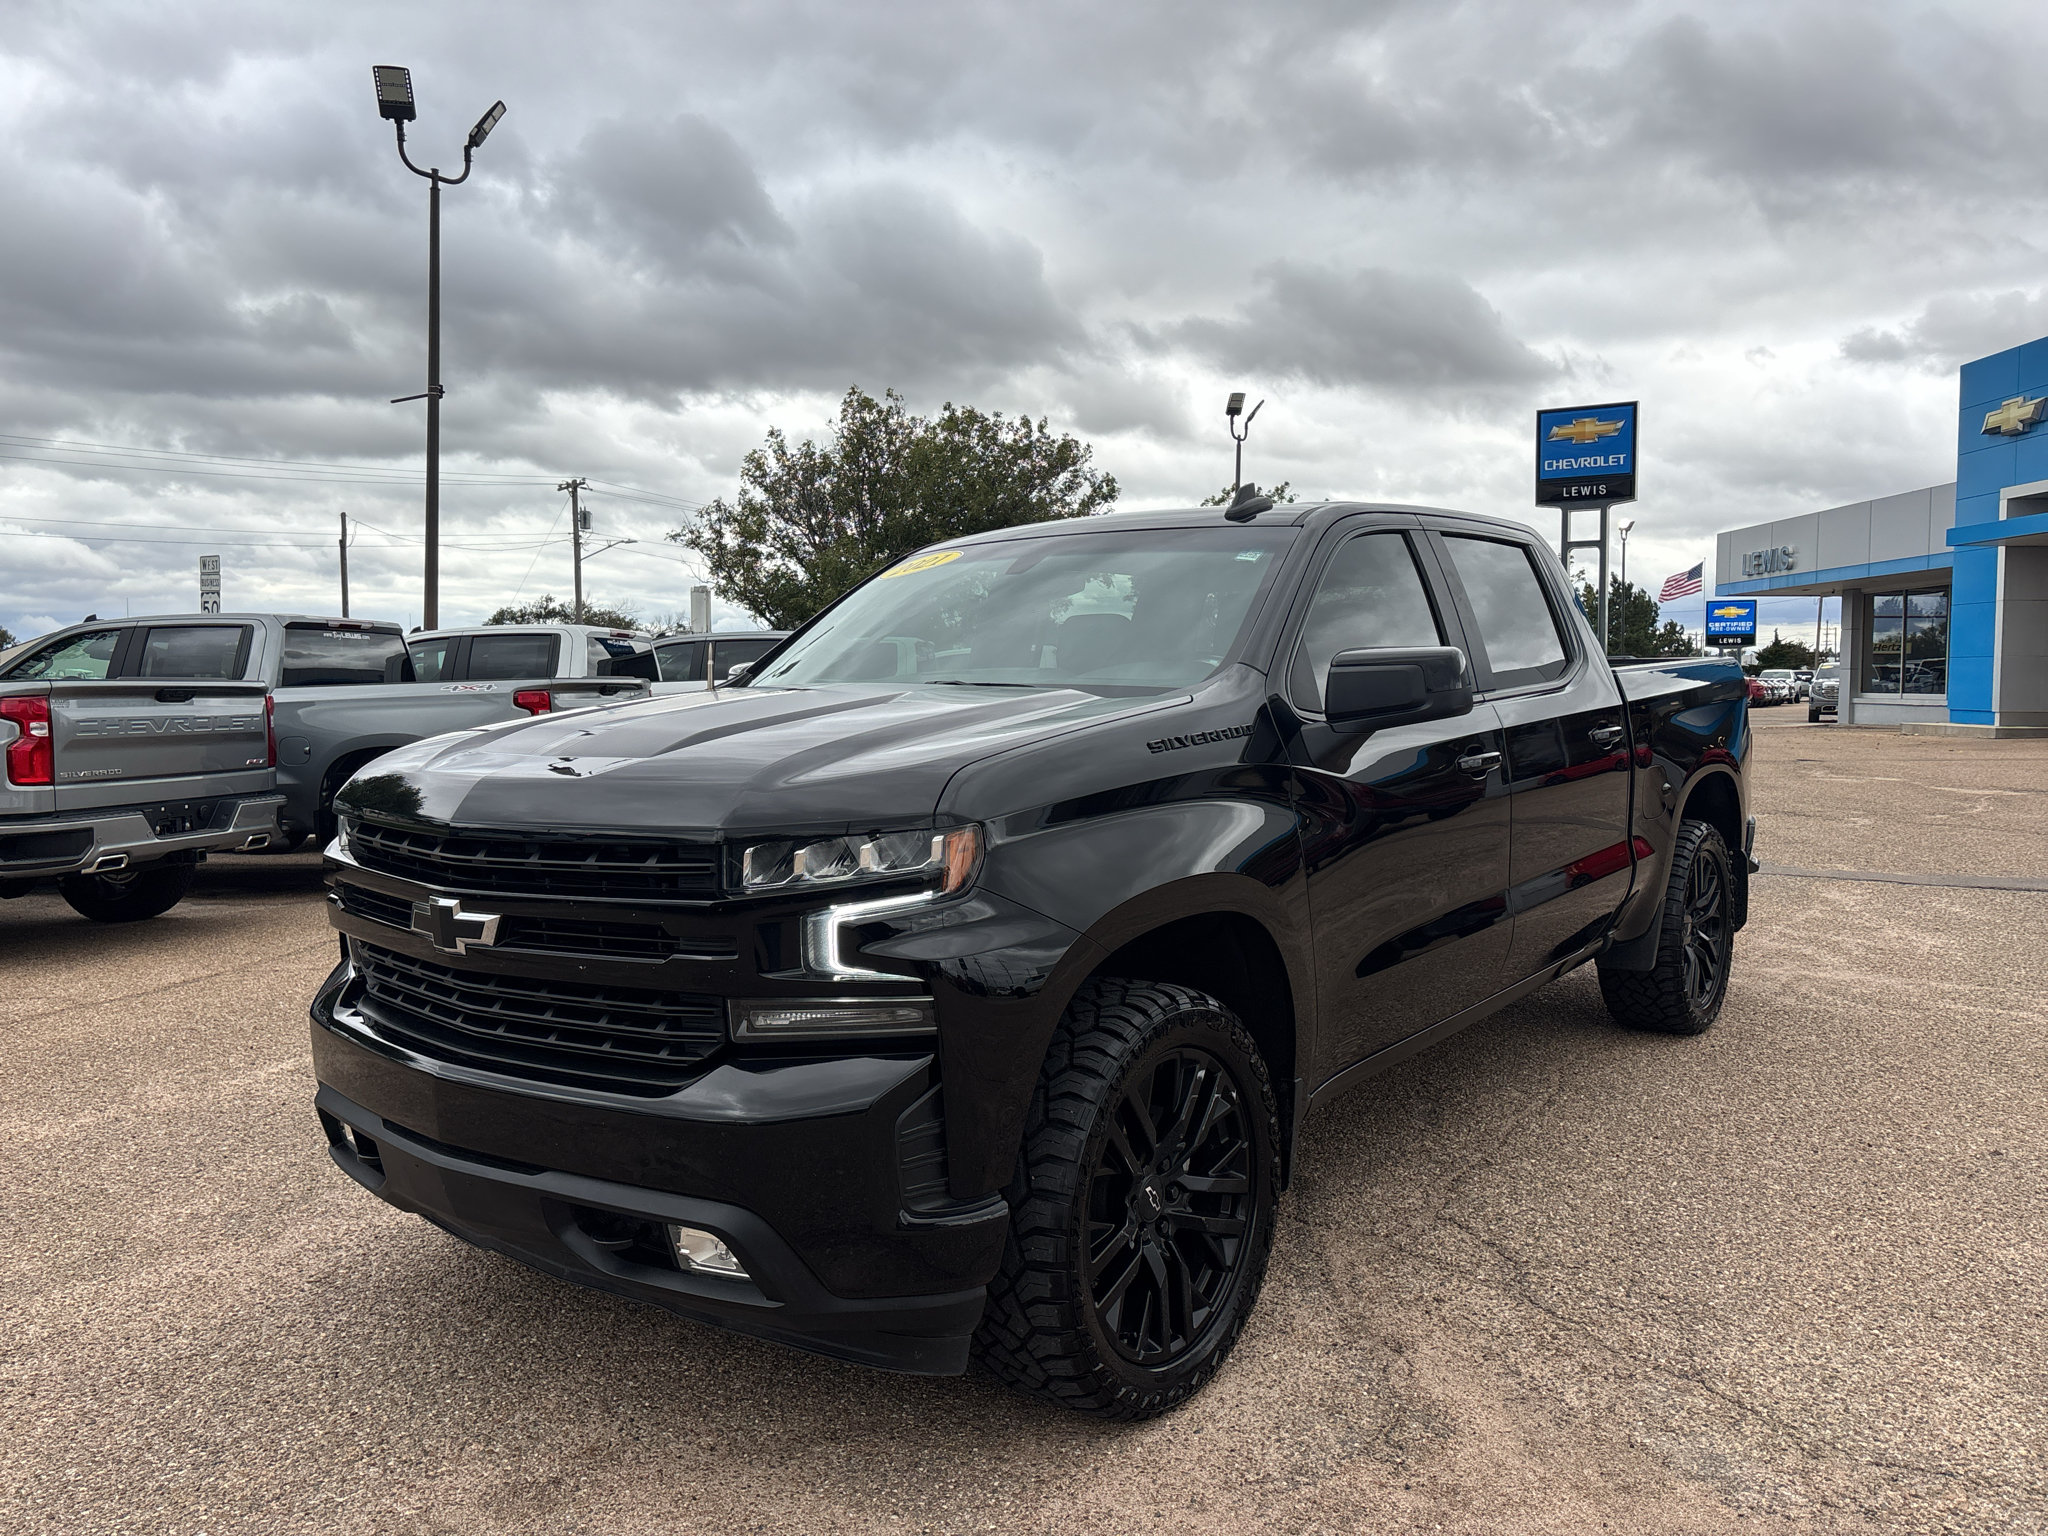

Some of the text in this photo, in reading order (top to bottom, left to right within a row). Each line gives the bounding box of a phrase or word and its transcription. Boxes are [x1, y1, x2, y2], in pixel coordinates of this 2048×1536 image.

[1544, 454, 1626, 471] CHEVROLET
[1563, 484, 1607, 497] LEWIS
[202, 559, 219, 571] WEST
[1742, 546, 1793, 576] LEWIS
[203, 600, 219, 614] 50
[1873, 642, 1901, 652] Hertz
[76, 716, 260, 736] CHEVROLET
[1146, 724, 1257, 755] SILVERADO
[60, 768, 122, 778] SILVERADO
